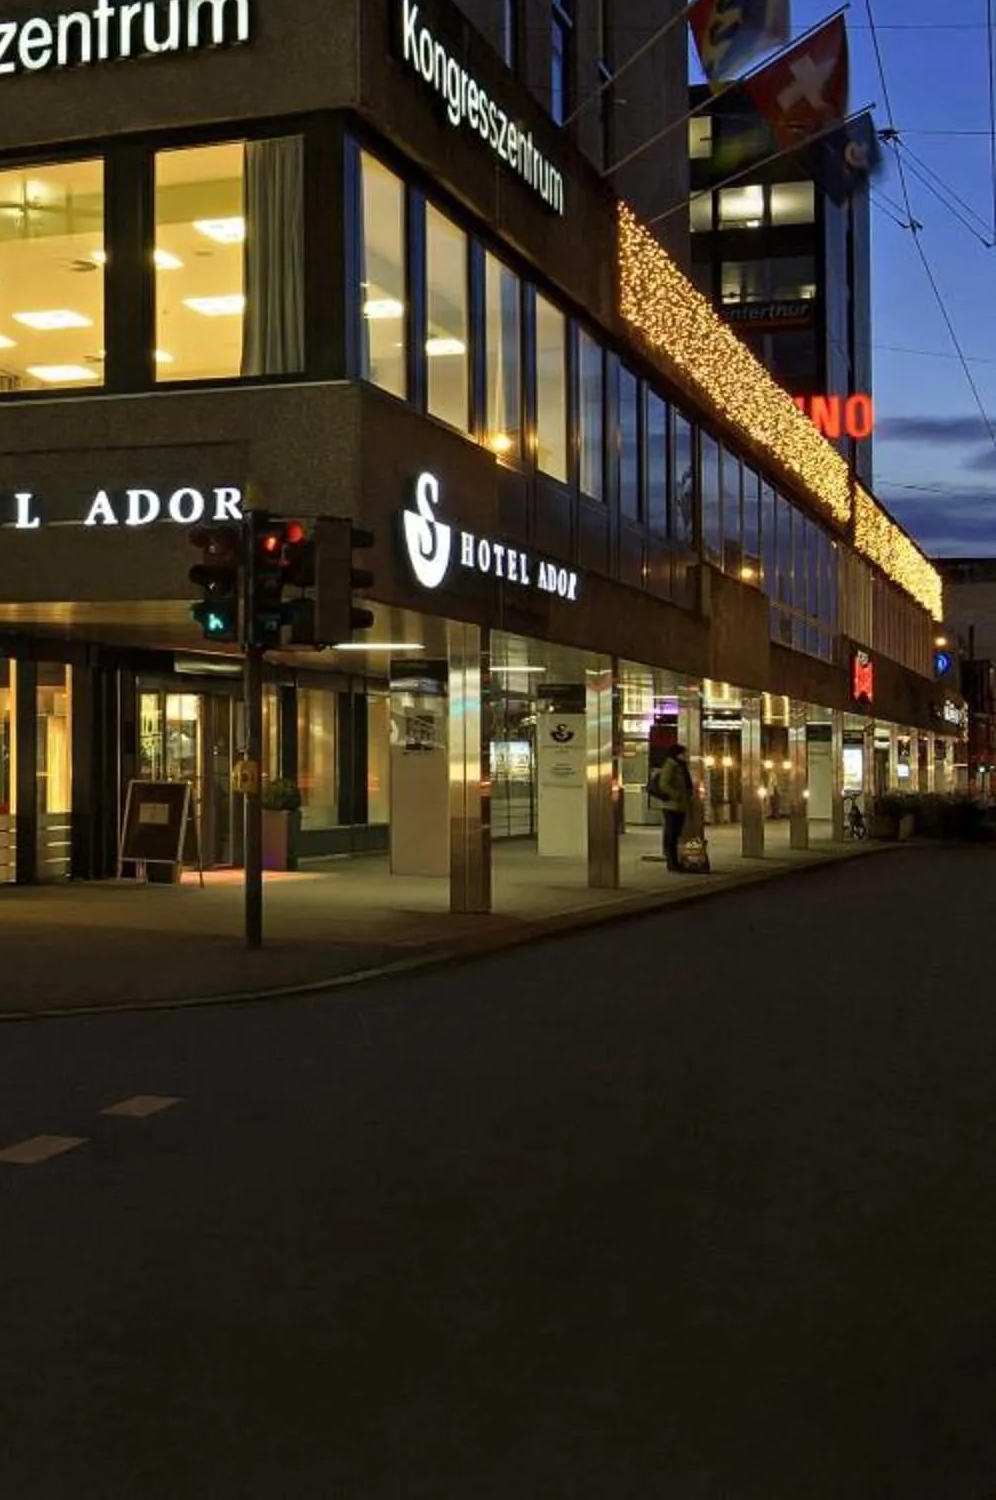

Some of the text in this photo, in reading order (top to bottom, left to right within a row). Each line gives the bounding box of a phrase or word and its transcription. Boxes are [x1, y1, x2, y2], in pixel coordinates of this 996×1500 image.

[83, 487, 243, 527] ADOR
[460, 531, 578, 601] HOTEL ADOR
